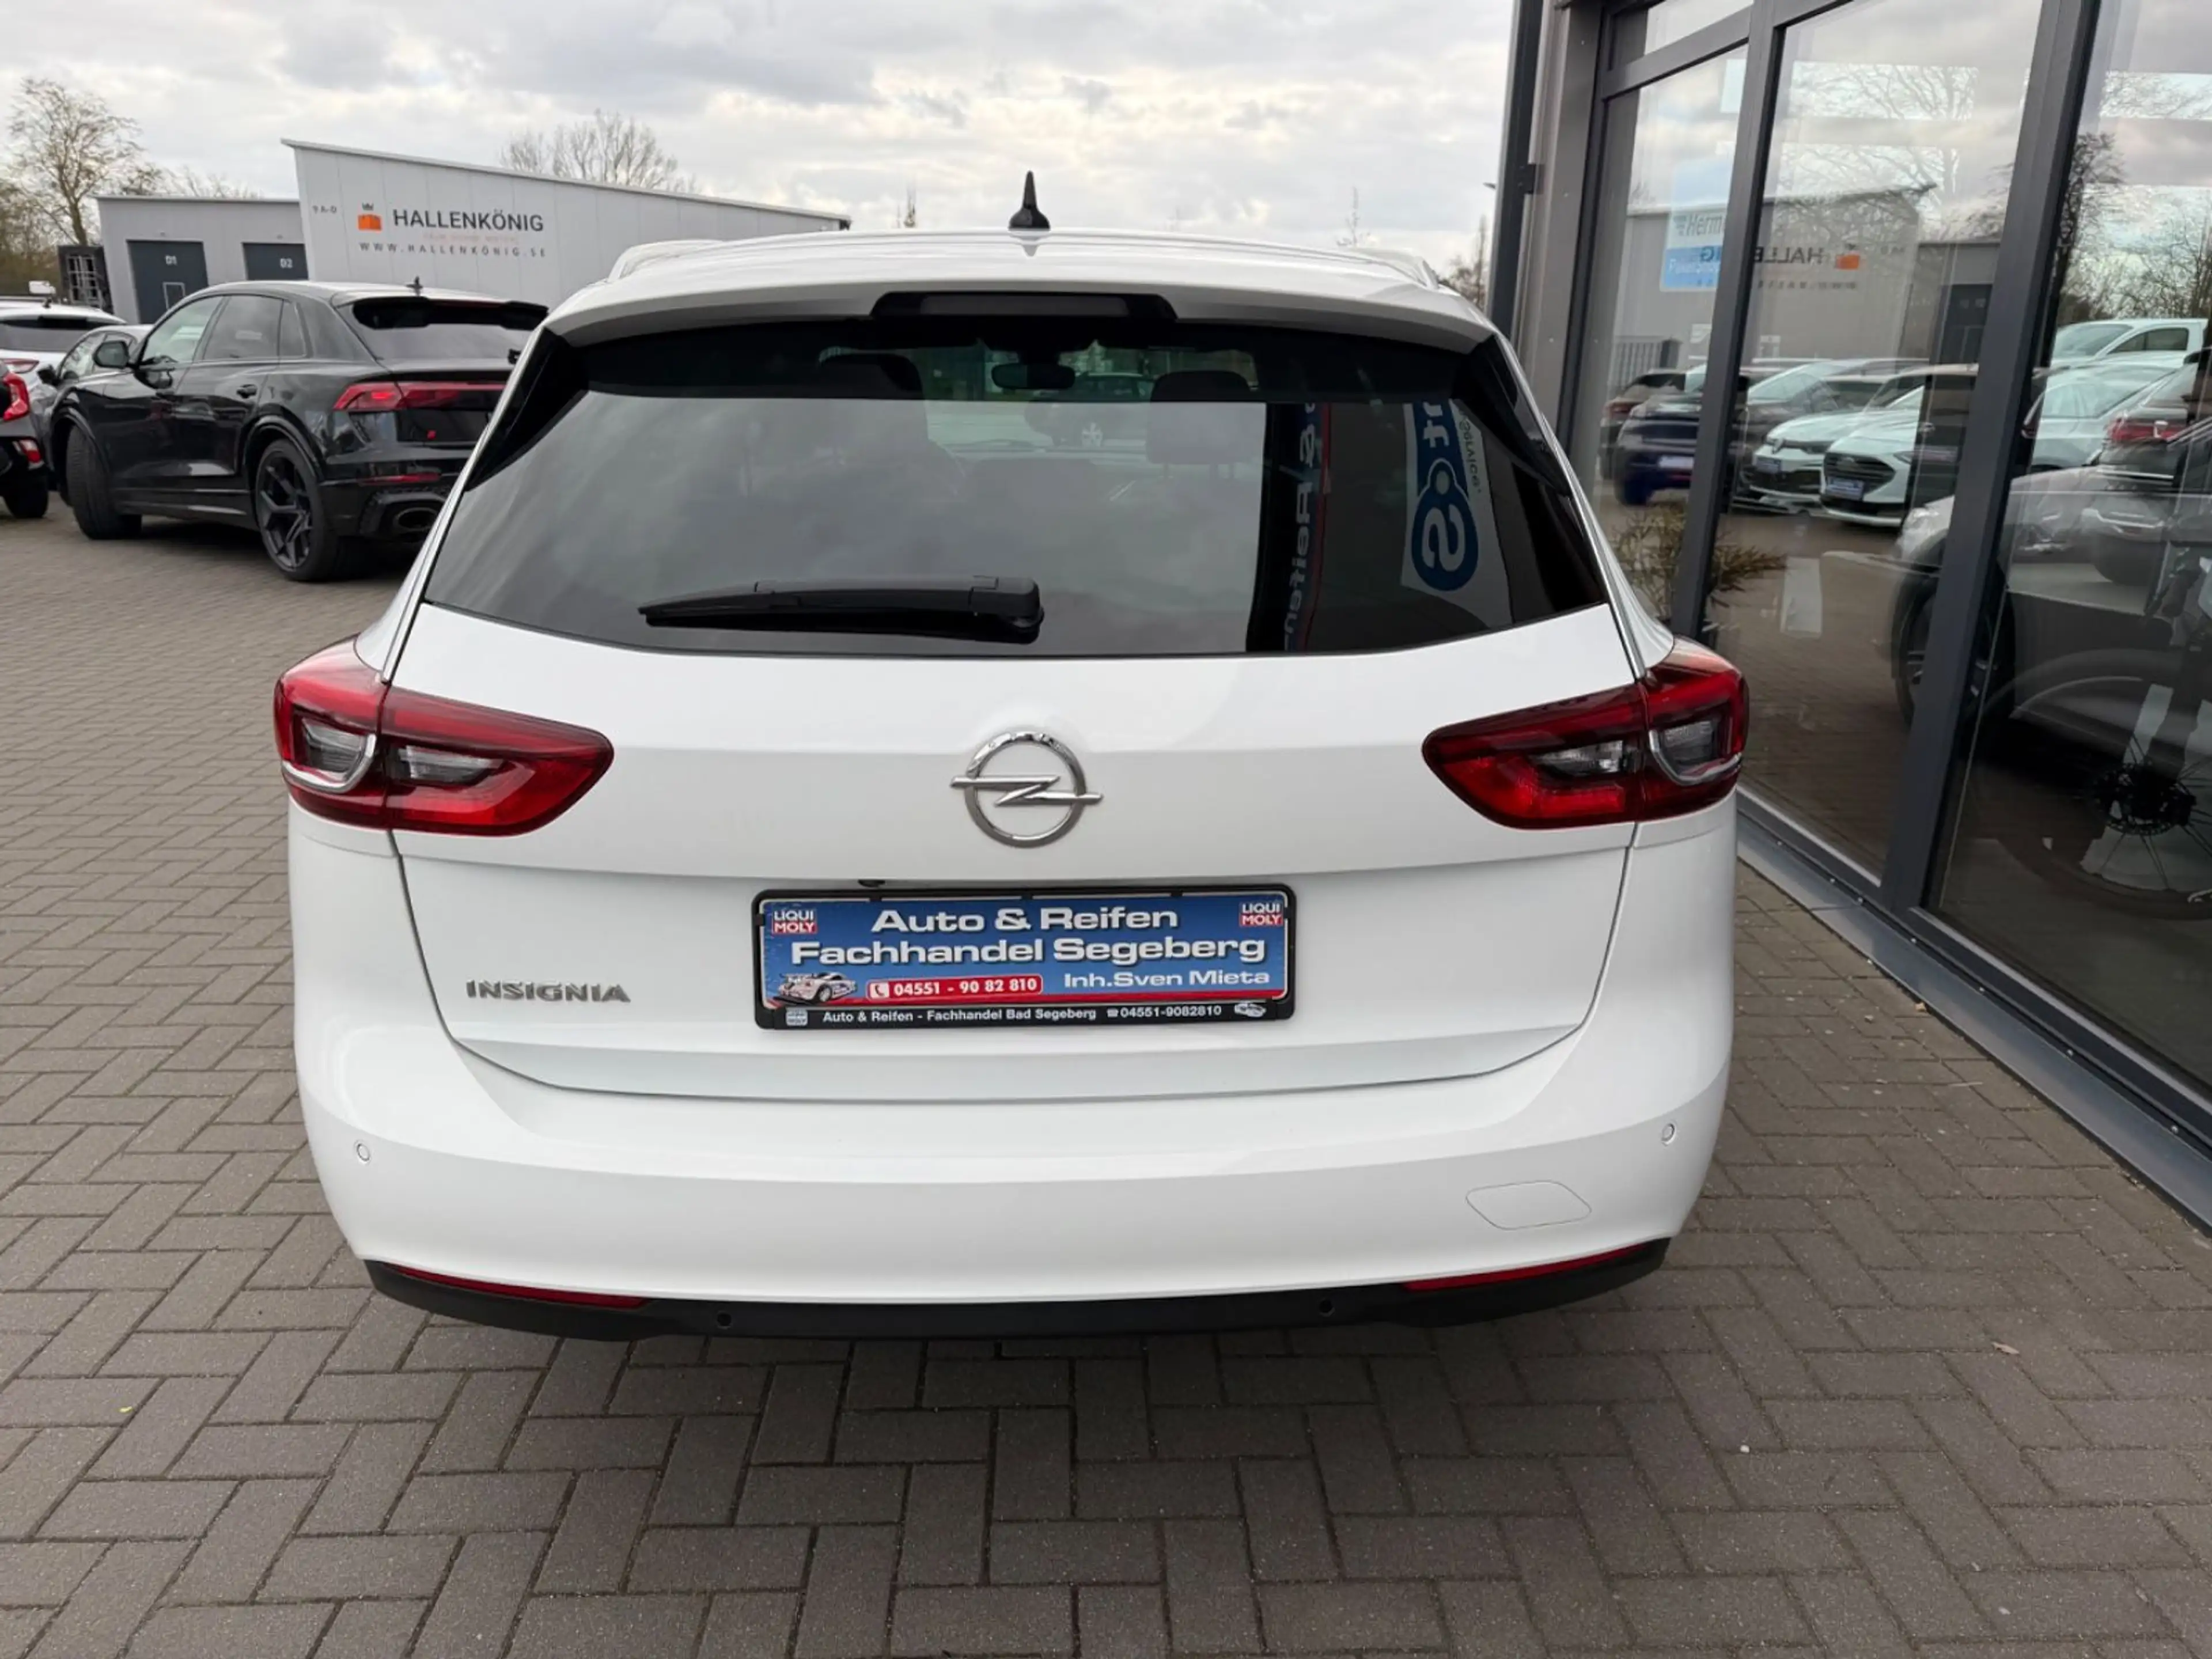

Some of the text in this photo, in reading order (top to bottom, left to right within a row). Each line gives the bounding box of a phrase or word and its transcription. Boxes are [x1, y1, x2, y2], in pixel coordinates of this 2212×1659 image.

[393, 209, 543, 231] HALLENKÖNIG
[774, 910, 814, 921] LIQUI
[1242, 903, 1281, 914] LIQUI
[774, 922, 815, 933] MOLY
[871, 907, 1178, 932] Auto & Reifen
[1242, 914, 1282, 926] MOLY
[791, 935, 1264, 966] Fachhandel Segeberg
[1190, 970, 1270, 986] Mieta
[466, 979, 631, 1002] INSIGNIA
[894, 982, 940, 996] 04551
[960, 980, 979, 994] 90
[985, 979, 1003, 993] 82
[1010, 978, 1037, 991] 810
[823, 1011, 854, 1022] Auto
[857, 1011, 867, 1022] &
[872, 1009, 914, 1022] Reifen
[927, 1008, 1002, 1021] Fachhandel
[1006, 1007, 1031, 1020] Bad
[1035, 1007, 1096, 1021] Segeberg
[1120, 1005, 1222, 1018] 04551-9082810
